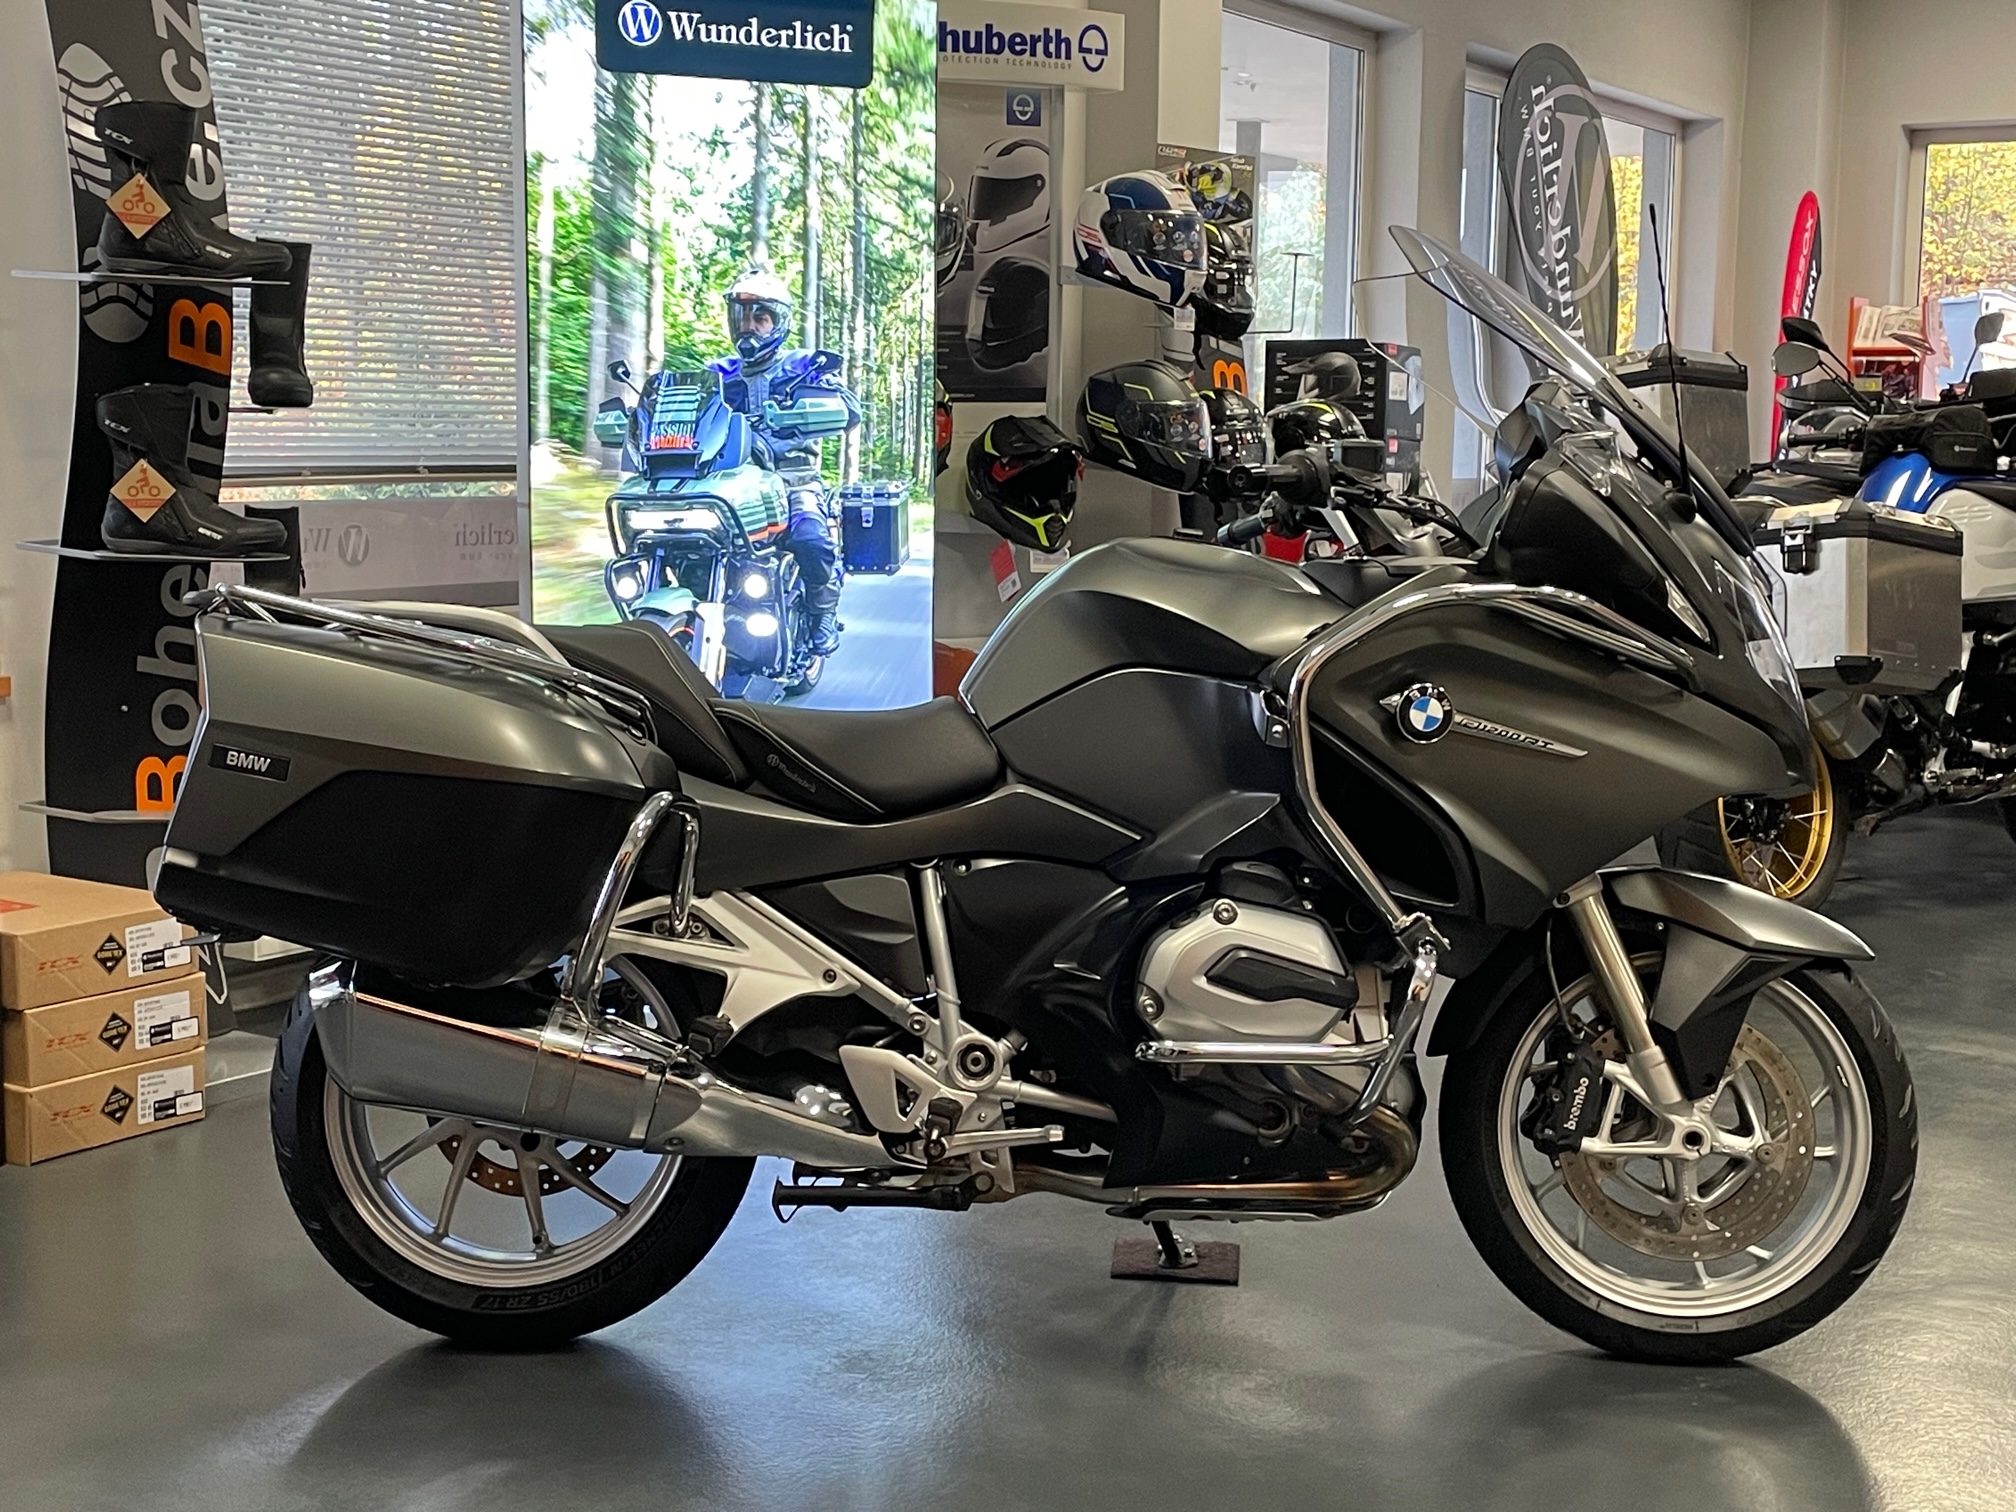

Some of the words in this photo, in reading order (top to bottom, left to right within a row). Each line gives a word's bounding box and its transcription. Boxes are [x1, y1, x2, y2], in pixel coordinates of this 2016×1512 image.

[667, 10, 853, 53] Wunderlich
[940, 56, 999, 65] OTECTION
[1006, 57, 1072, 71] TECHNOLOGY
[226, 750, 271, 773] BMW
[1563, 1077, 1590, 1131] brembo
